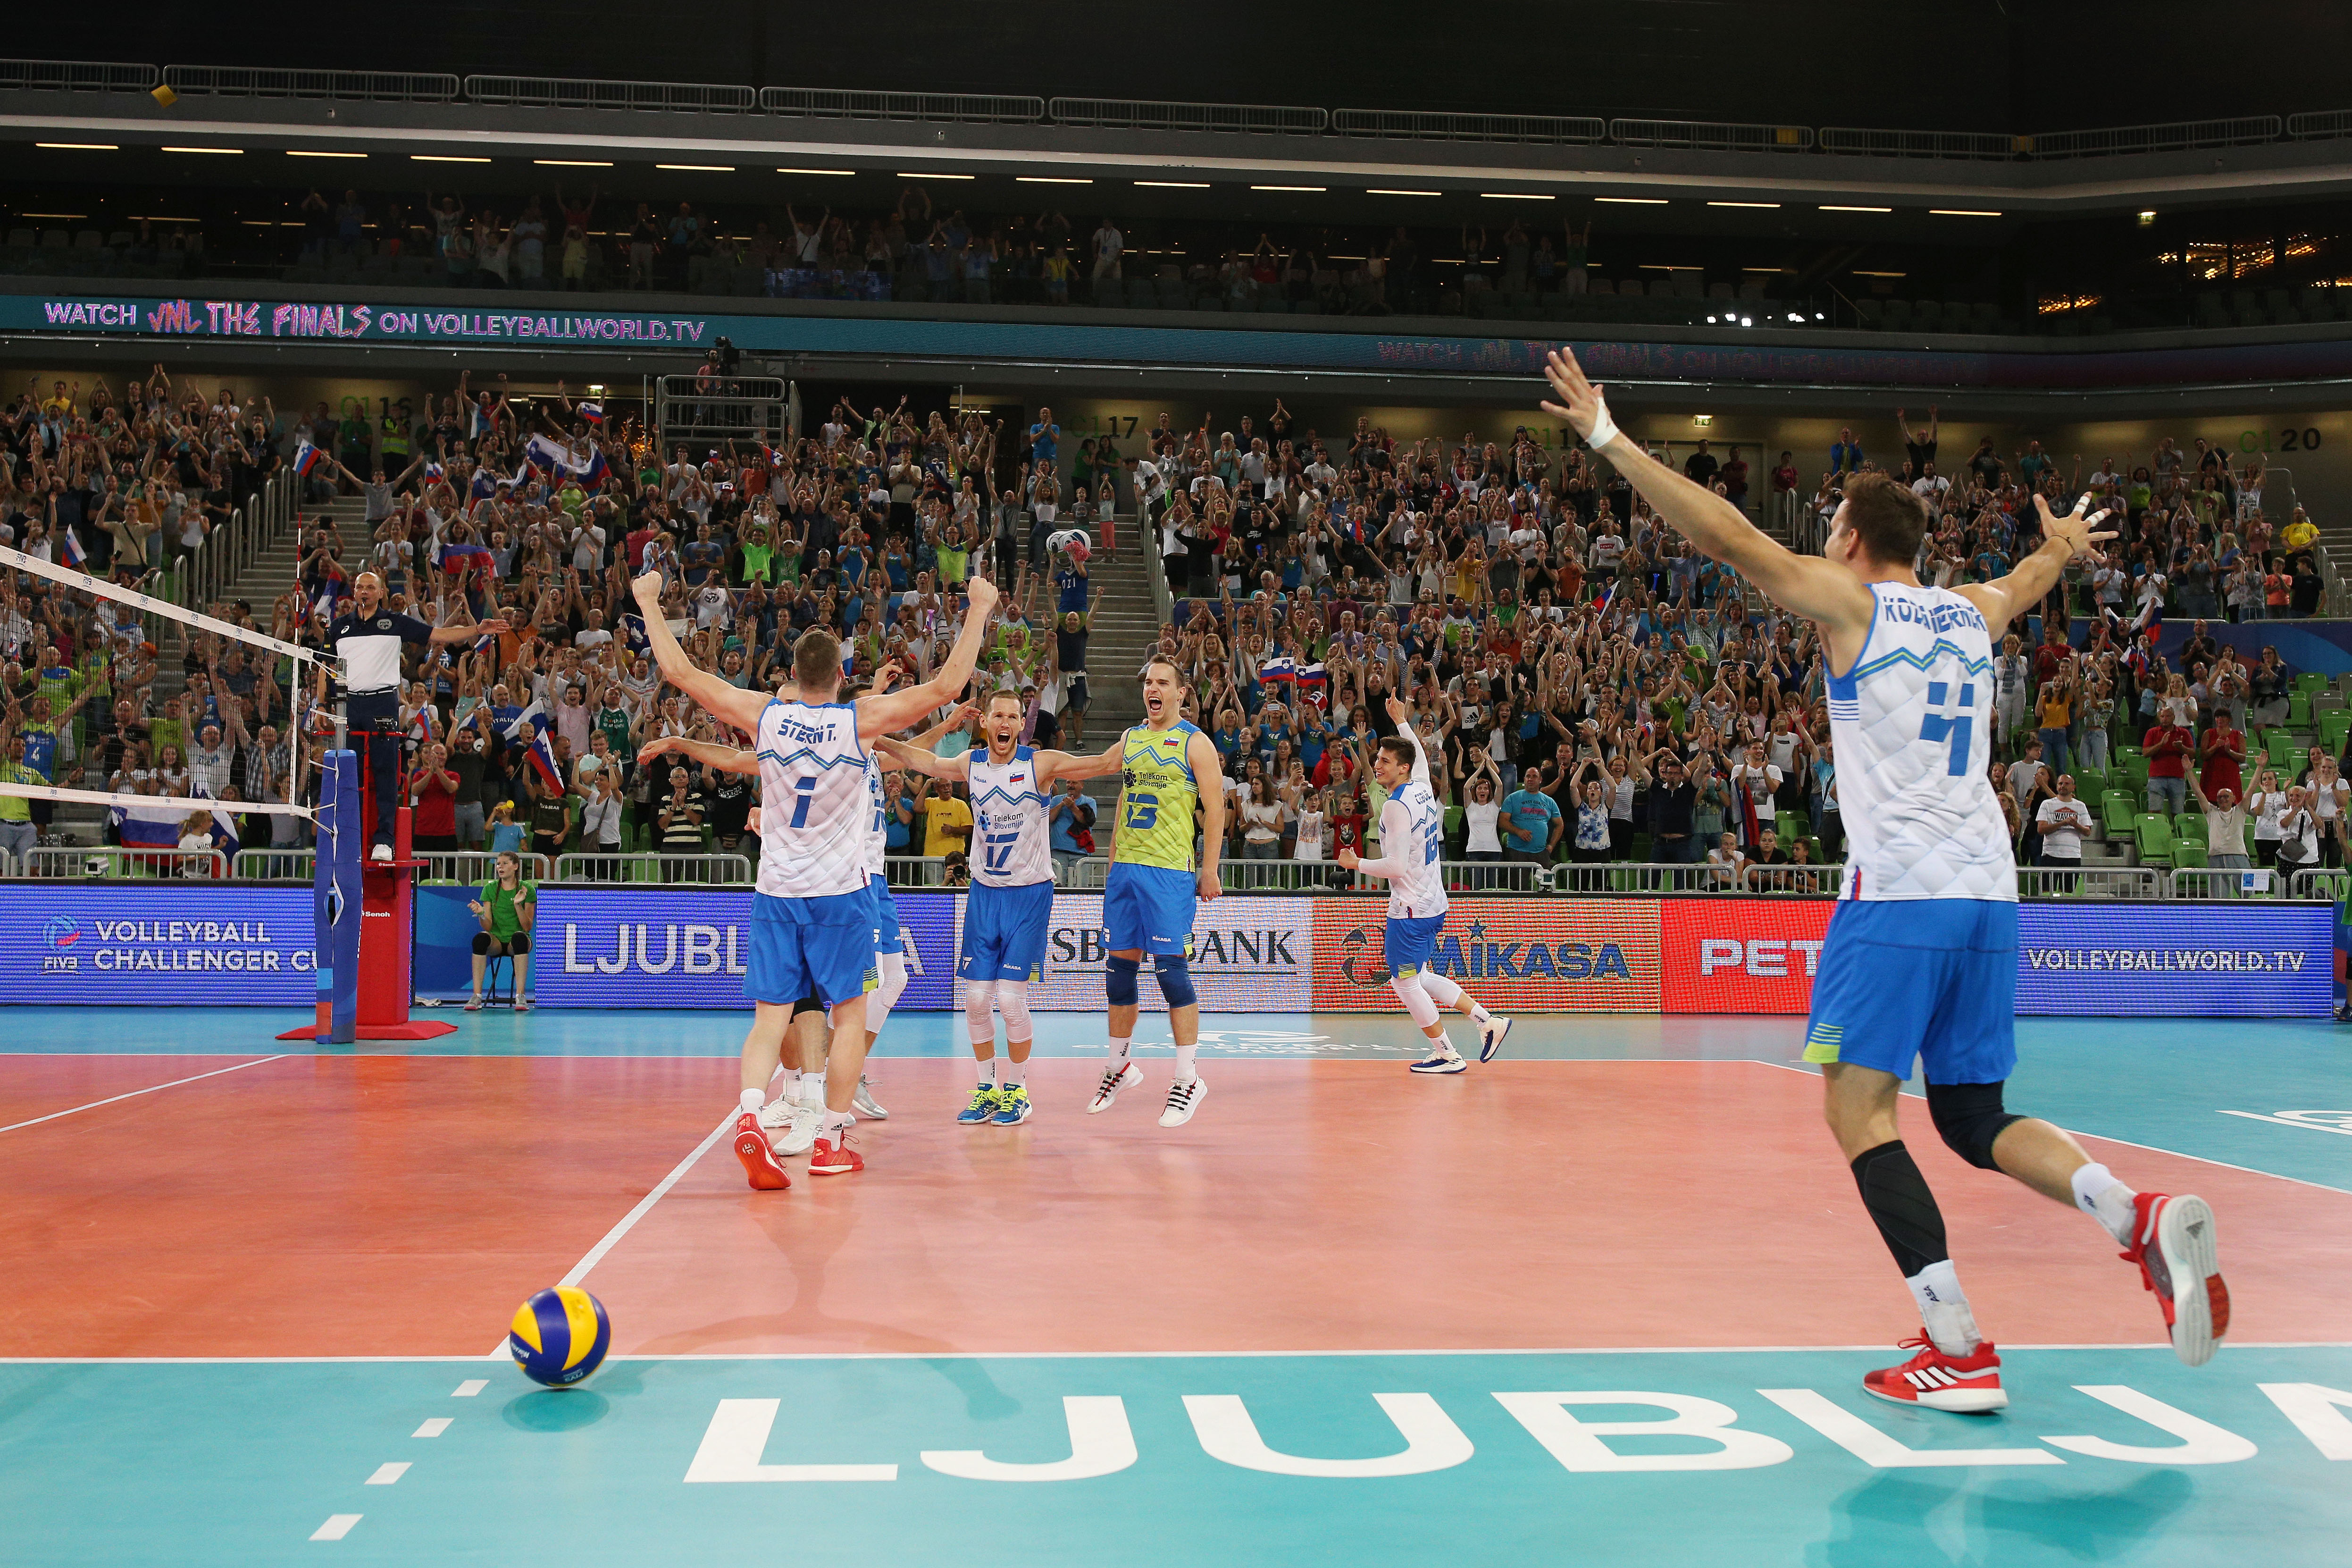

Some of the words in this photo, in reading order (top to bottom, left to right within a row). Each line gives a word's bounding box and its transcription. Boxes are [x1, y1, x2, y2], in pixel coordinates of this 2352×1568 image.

[44, 302, 136, 326] WATCH
[205, 301, 260, 335] THE
[272, 303, 371, 338] FINALS
[379, 312, 417, 334] ON
[423, 312, 706, 342] VOLLEYBALLWORLD.TV
[1378, 342, 1462, 363] WATCH
[1108, 415, 1139, 439] 17
[2280, 428, 2321, 451] 20
[1919, 681, 1975, 777] 4
[1138, 771, 1168, 780] Telekom
[1138, 779, 1167, 788] Slovenije
[789, 776, 818, 829] 1
[1125, 792, 1159, 829] 13
[993, 812, 1024, 822] Telekom
[994, 820, 1024, 830] Slovenije
[985, 831, 1020, 868] 17
[94, 921, 272, 943] VOLLEYBALL
[44, 956, 78, 969] FIVB
[94, 949, 282, 972] CHALLENGER
[1431, 930, 1630, 980] MIKASA
[1700, 939, 1825, 976] PET
[2028, 948, 2305, 972] VOLLEYBALLWORLD.TV
